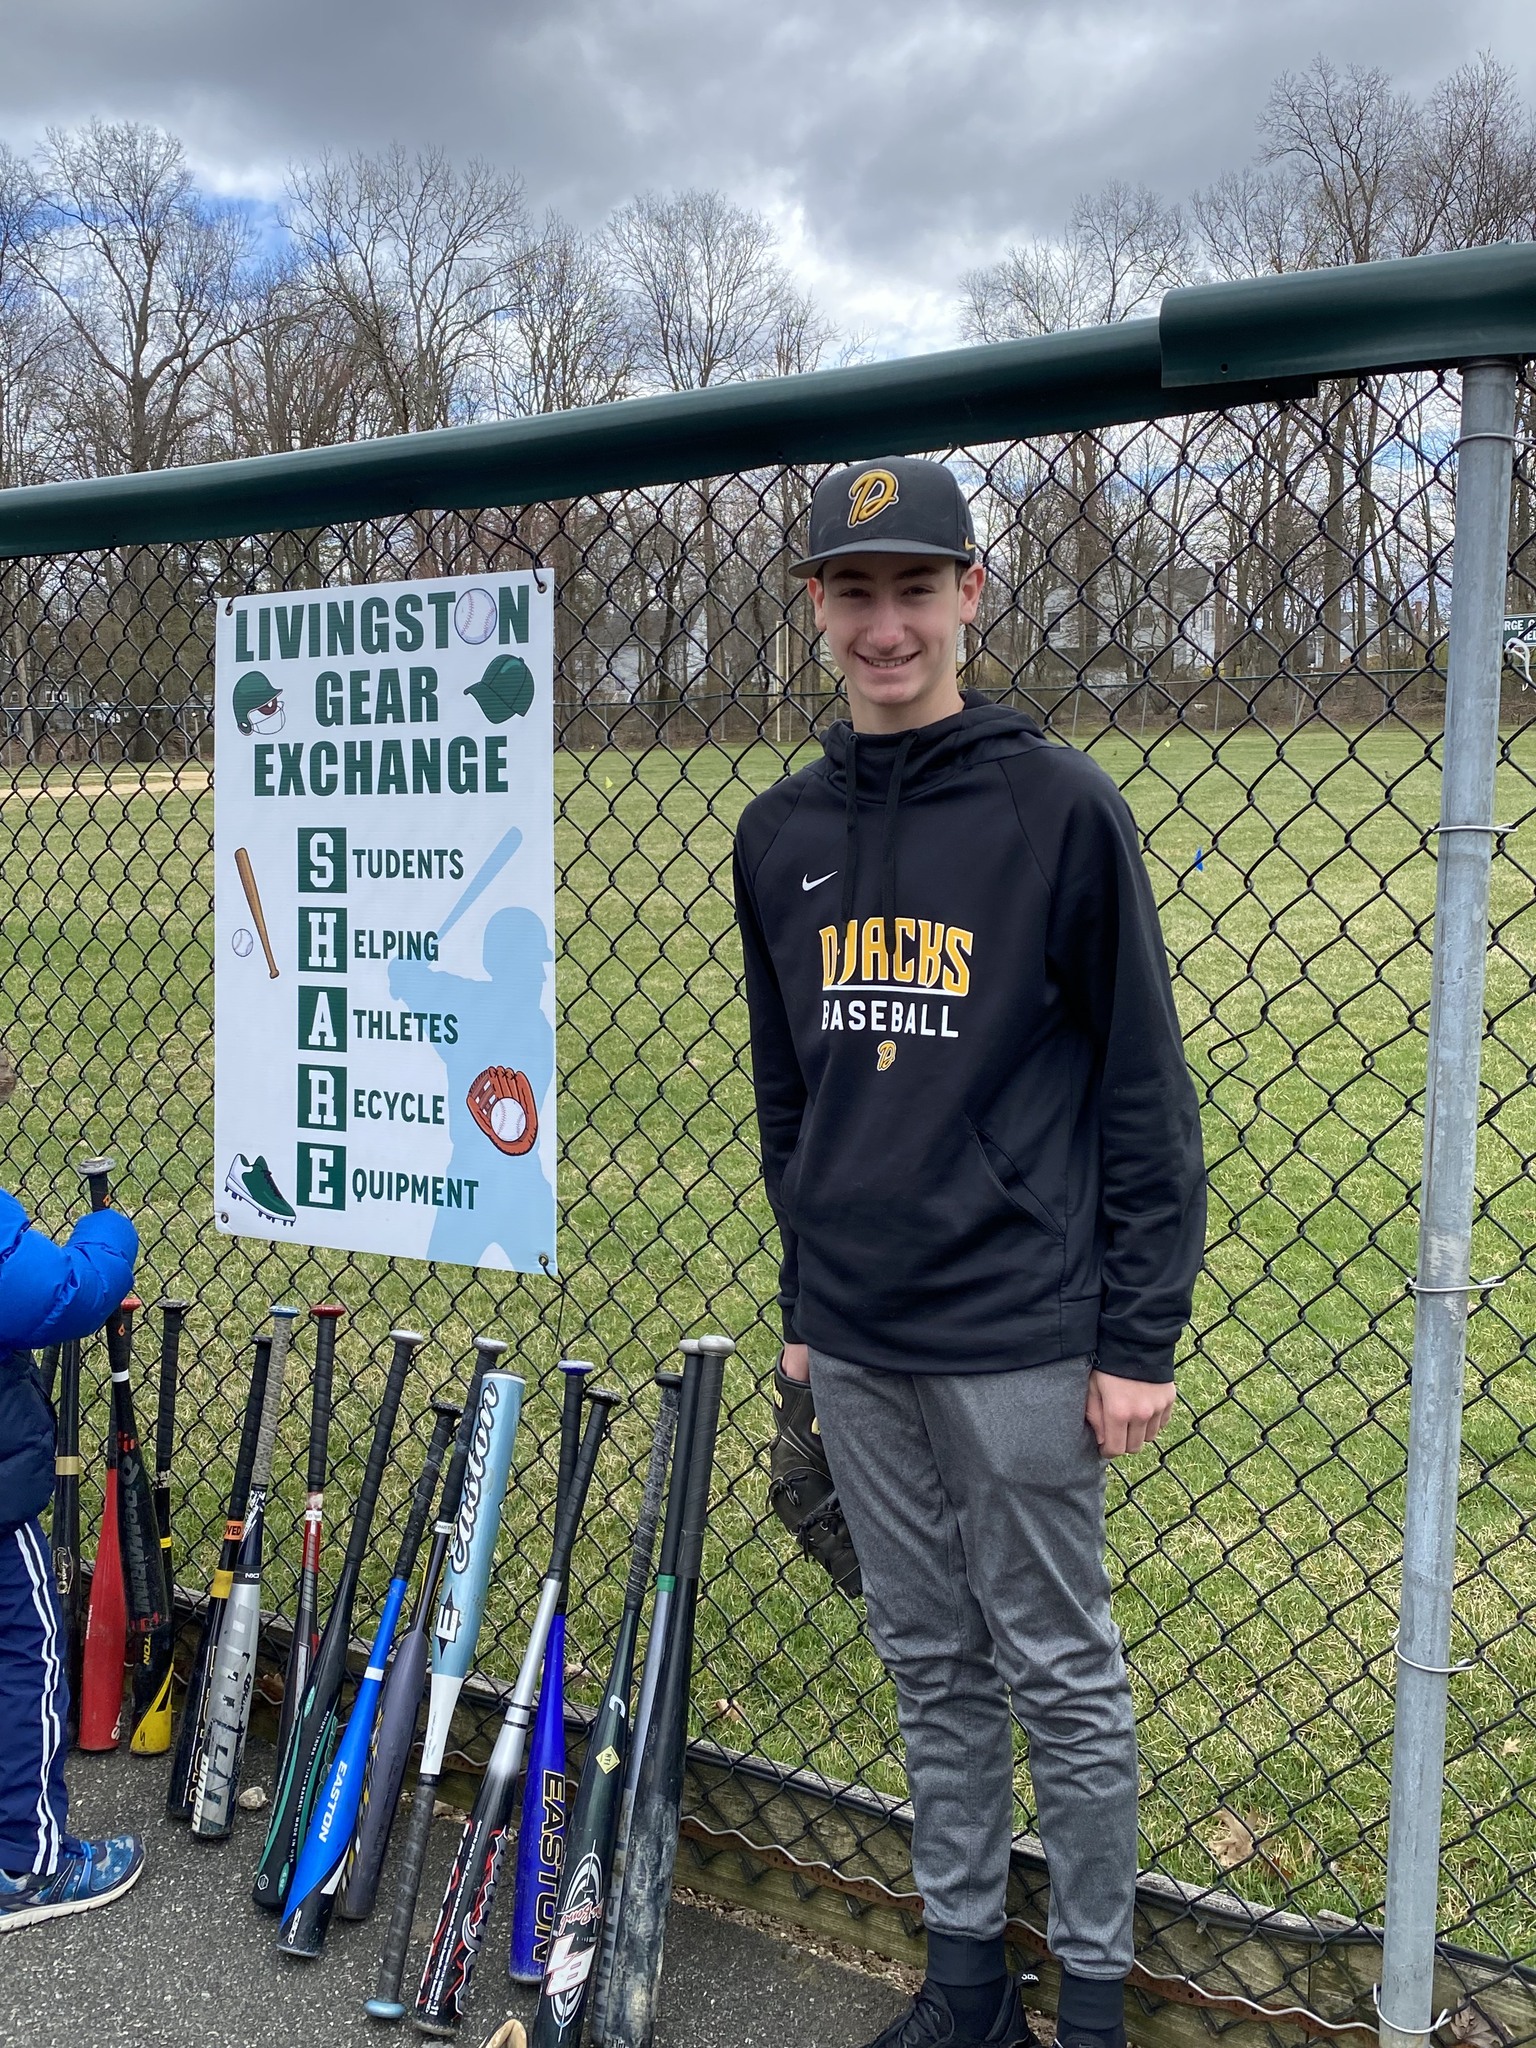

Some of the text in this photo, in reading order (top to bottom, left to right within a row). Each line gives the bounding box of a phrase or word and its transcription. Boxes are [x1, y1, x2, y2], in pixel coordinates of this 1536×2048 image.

[1503, 619, 1524, 631] RGE
[315, 666, 439, 728] GEAR
[254, 735, 509, 797] EXCHANGE
[821, 999, 959, 1038] BASEBALL
[225, 1525, 242, 1536] VED
[143, 1634, 152, 1666] TON
[318, 1759, 348, 1843] EASTON
[532, 1769, 566, 1963] EASTON
